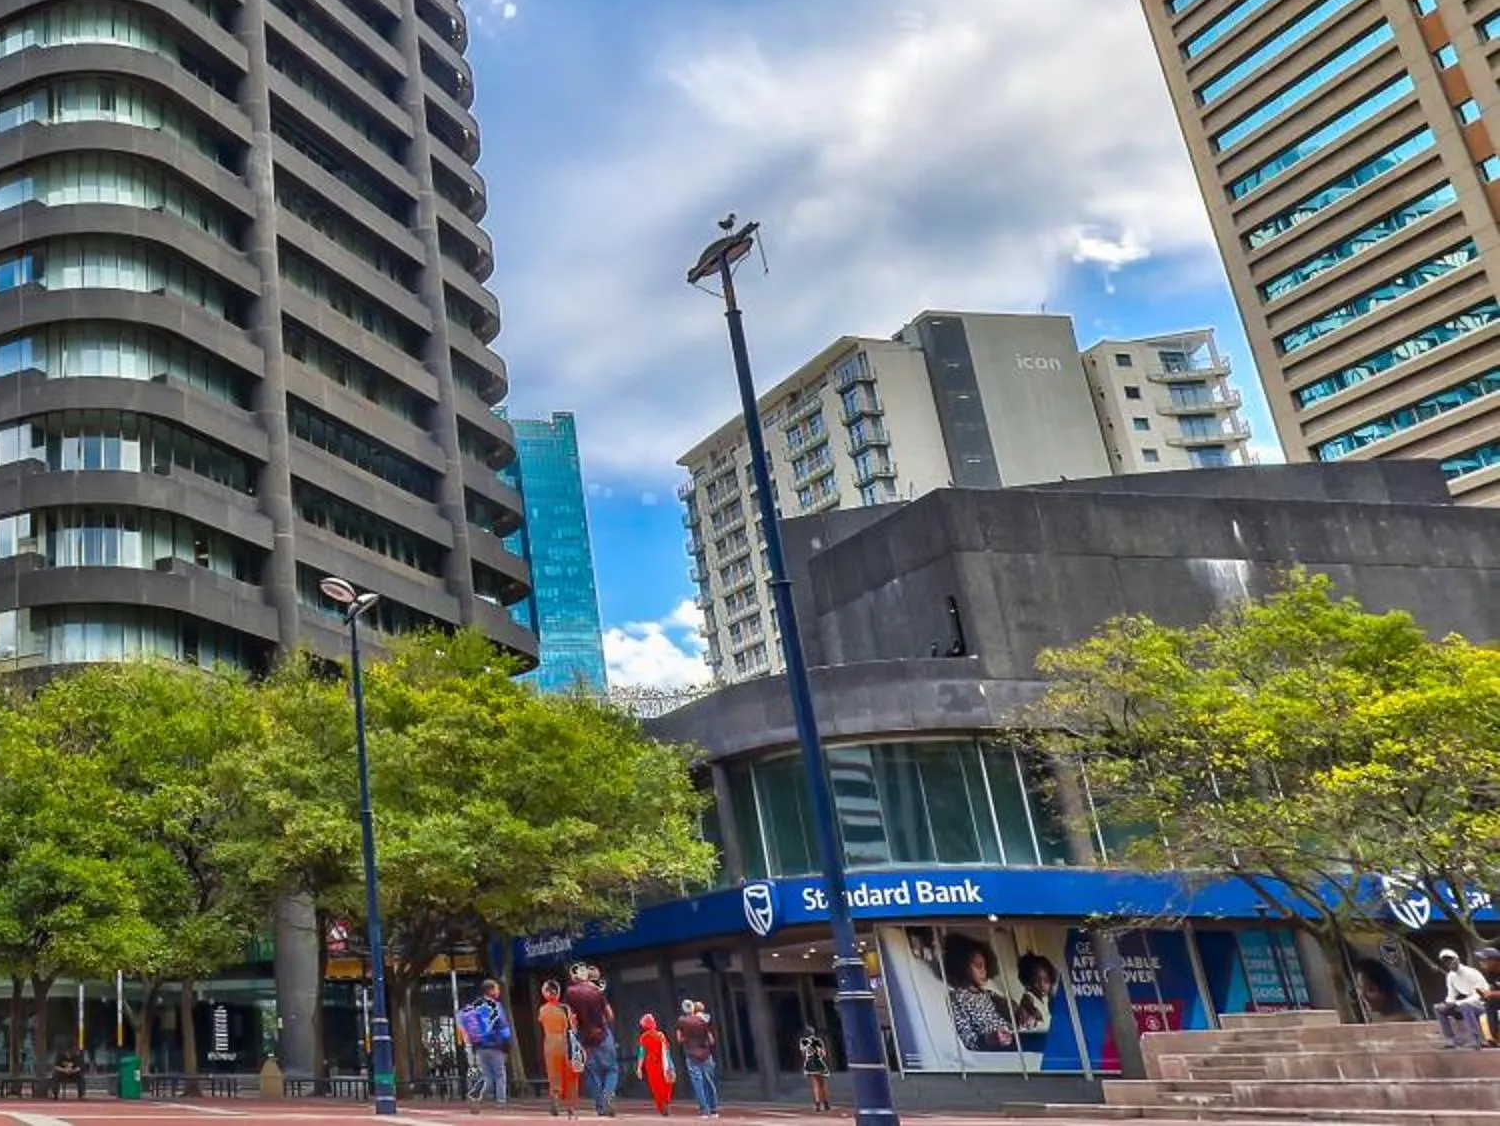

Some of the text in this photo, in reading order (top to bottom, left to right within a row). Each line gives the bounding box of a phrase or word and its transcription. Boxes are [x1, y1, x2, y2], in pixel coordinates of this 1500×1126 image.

[1015, 353, 1061, 371] icon
[802, 878, 983, 911] Stndard Bank
[1073, 956, 1162, 969] AFFABLE
